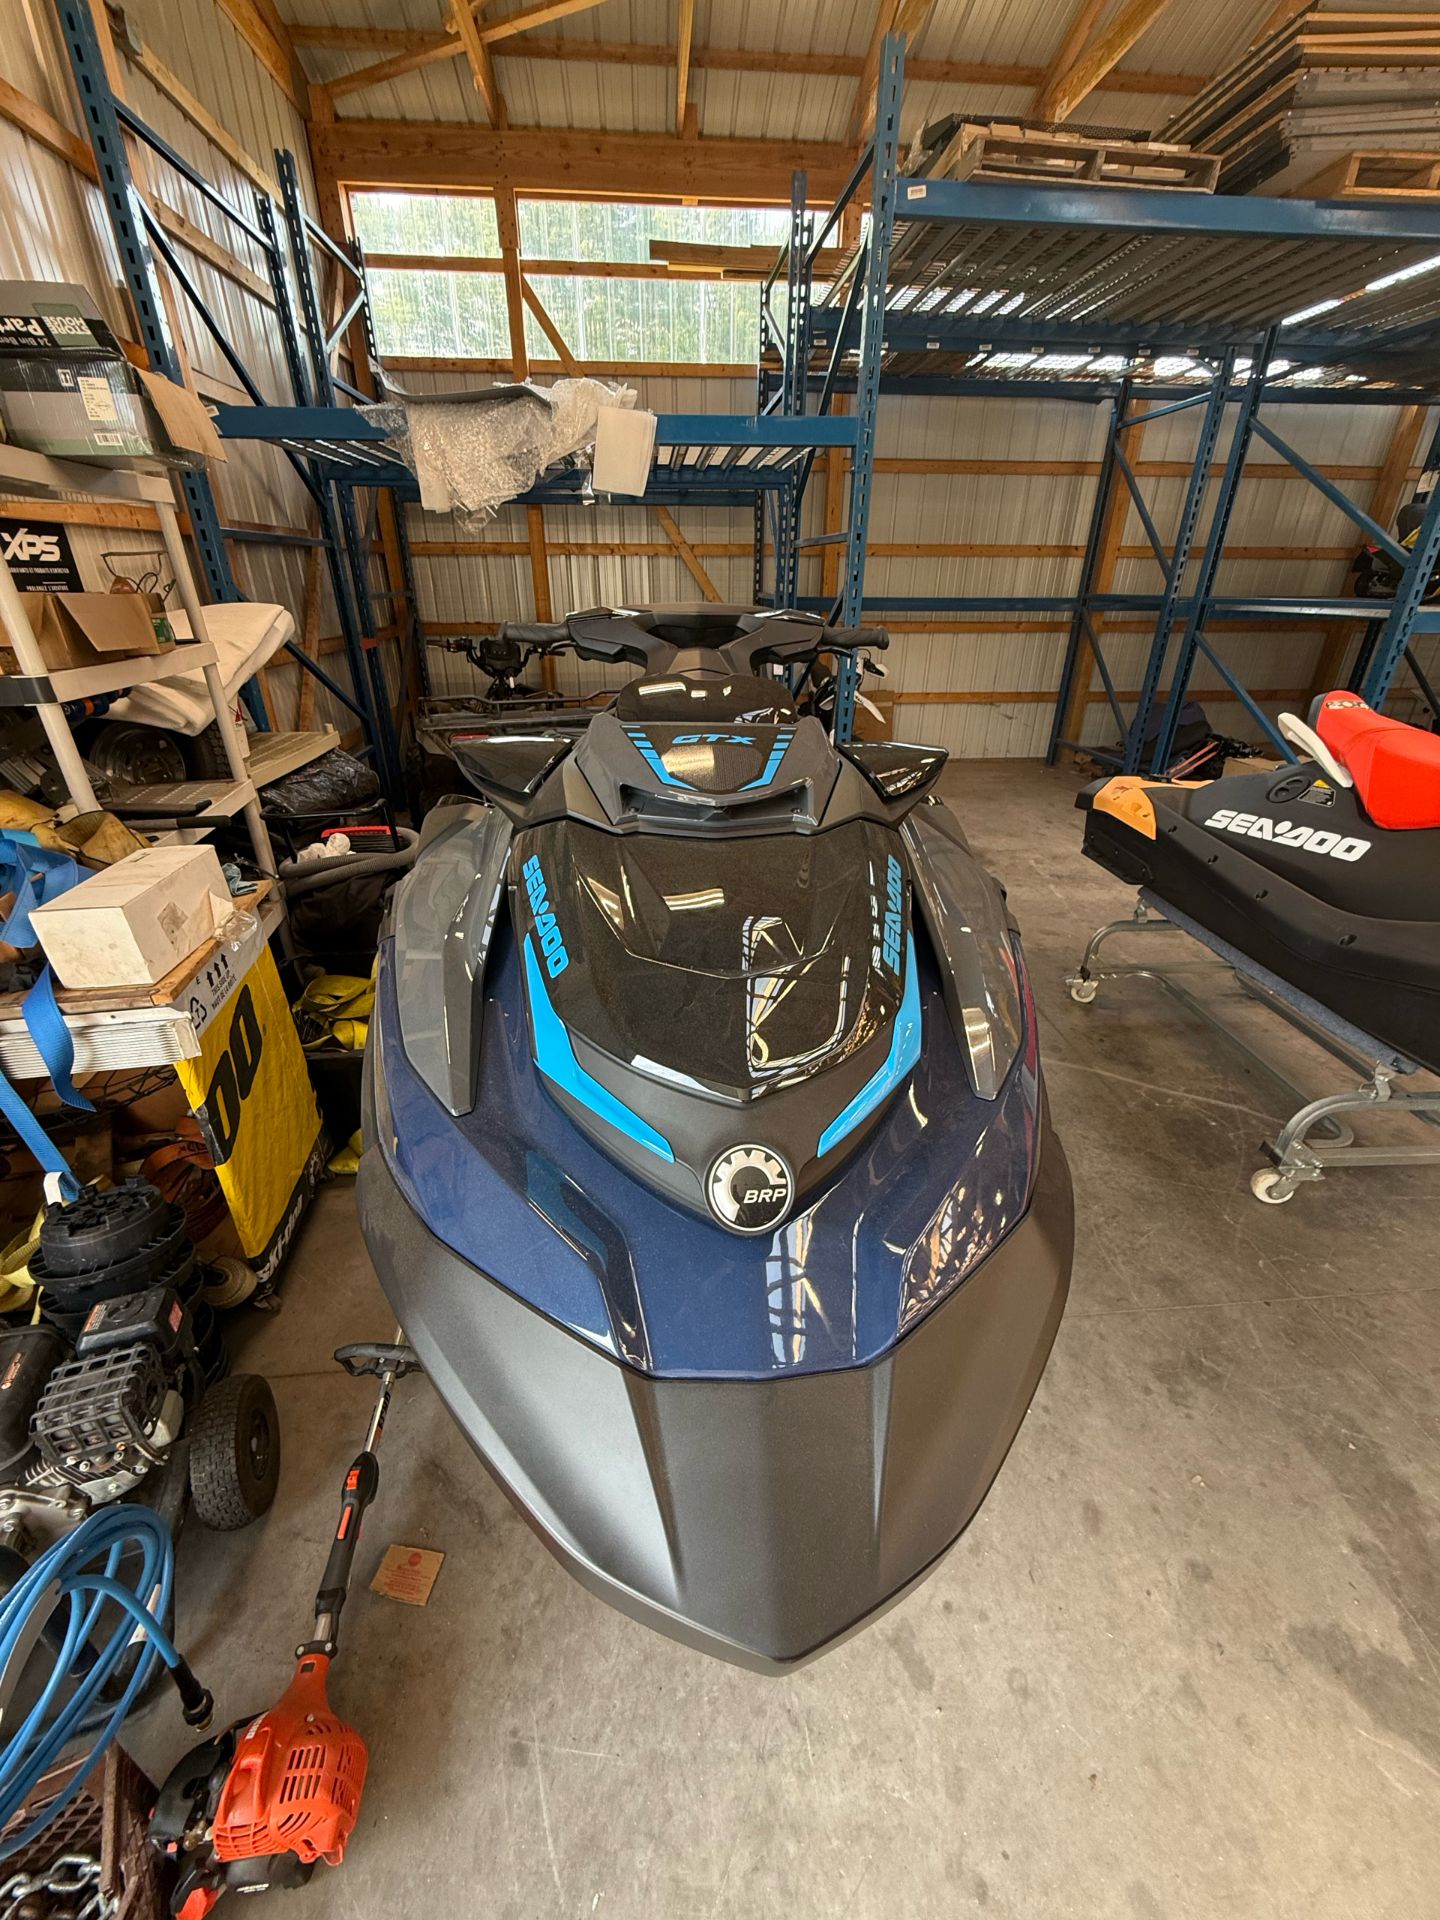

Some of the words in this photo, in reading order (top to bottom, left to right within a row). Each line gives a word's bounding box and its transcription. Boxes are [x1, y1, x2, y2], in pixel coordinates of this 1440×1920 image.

[41, 316, 86, 327] HOUSE
[0, 528, 61, 562] XPS
[672, 733, 757, 745] GTX
[743, 1188, 787, 1204] BRP
